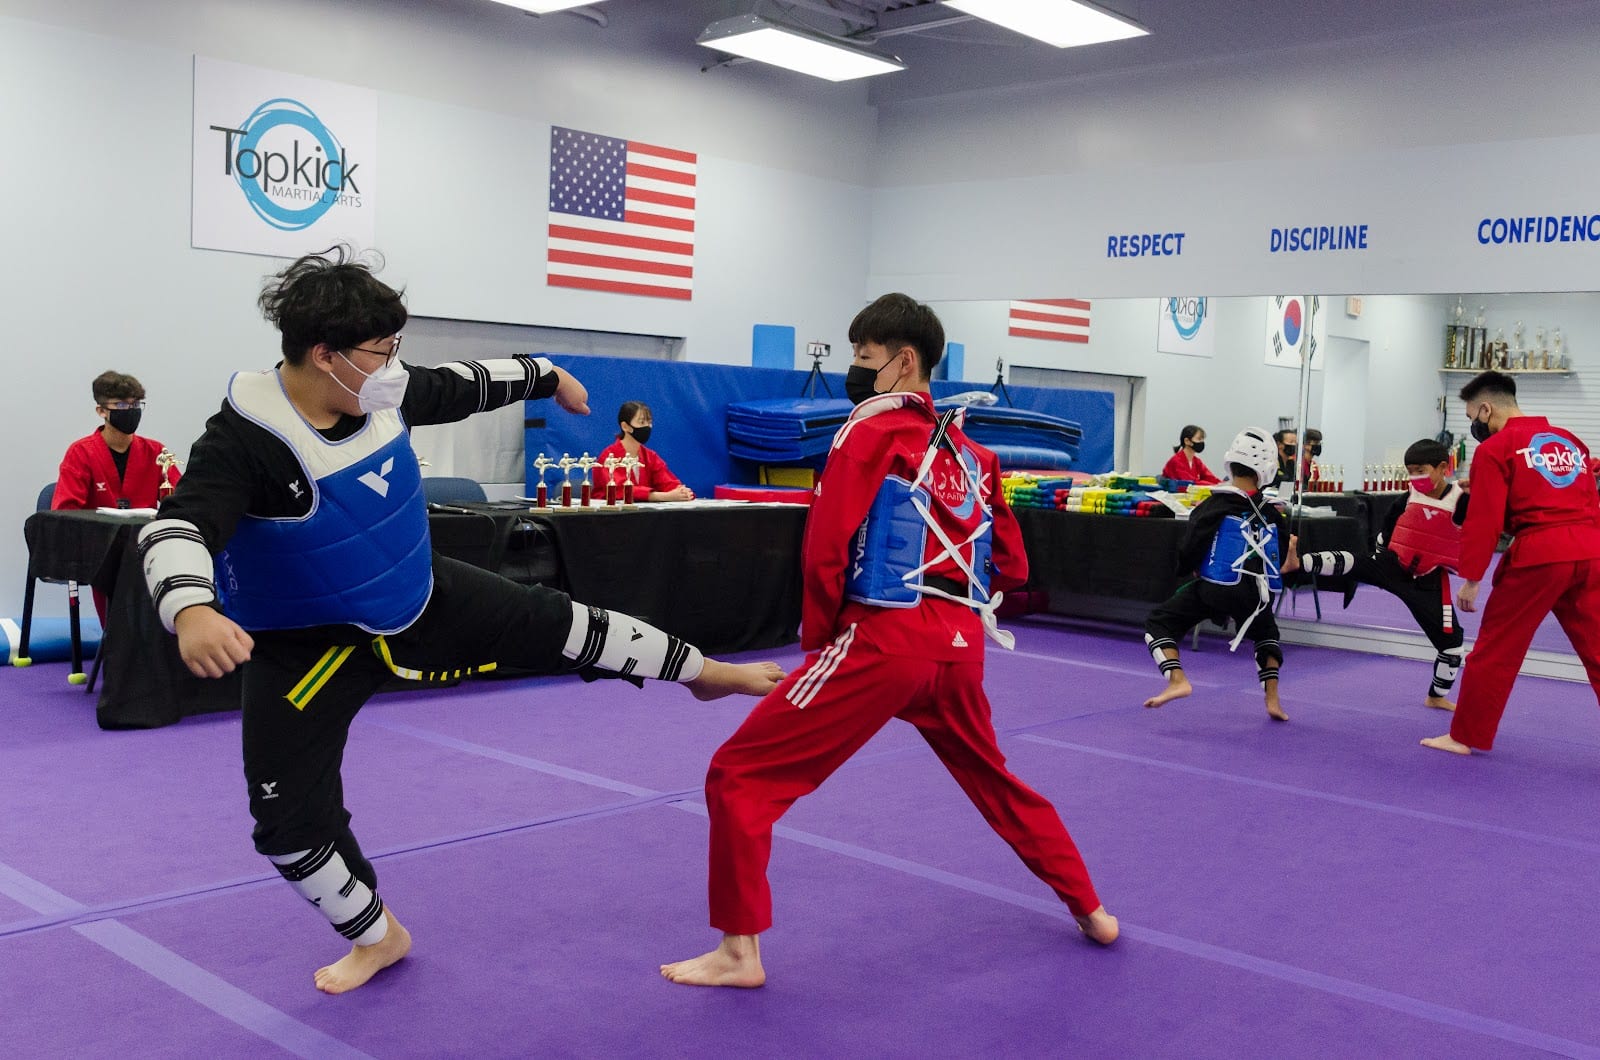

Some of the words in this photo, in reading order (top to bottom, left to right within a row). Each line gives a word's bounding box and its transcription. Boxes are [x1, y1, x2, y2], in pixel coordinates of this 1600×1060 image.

[210, 125, 360, 194] Topkick
[272, 184, 328, 204] MARTIAL
[331, 193, 362, 208] ARTS
[1107, 233, 1185, 257] RESPECT
[1270, 224, 1368, 252] DISCIPLINE
[1516, 446, 1588, 471] Topkick
